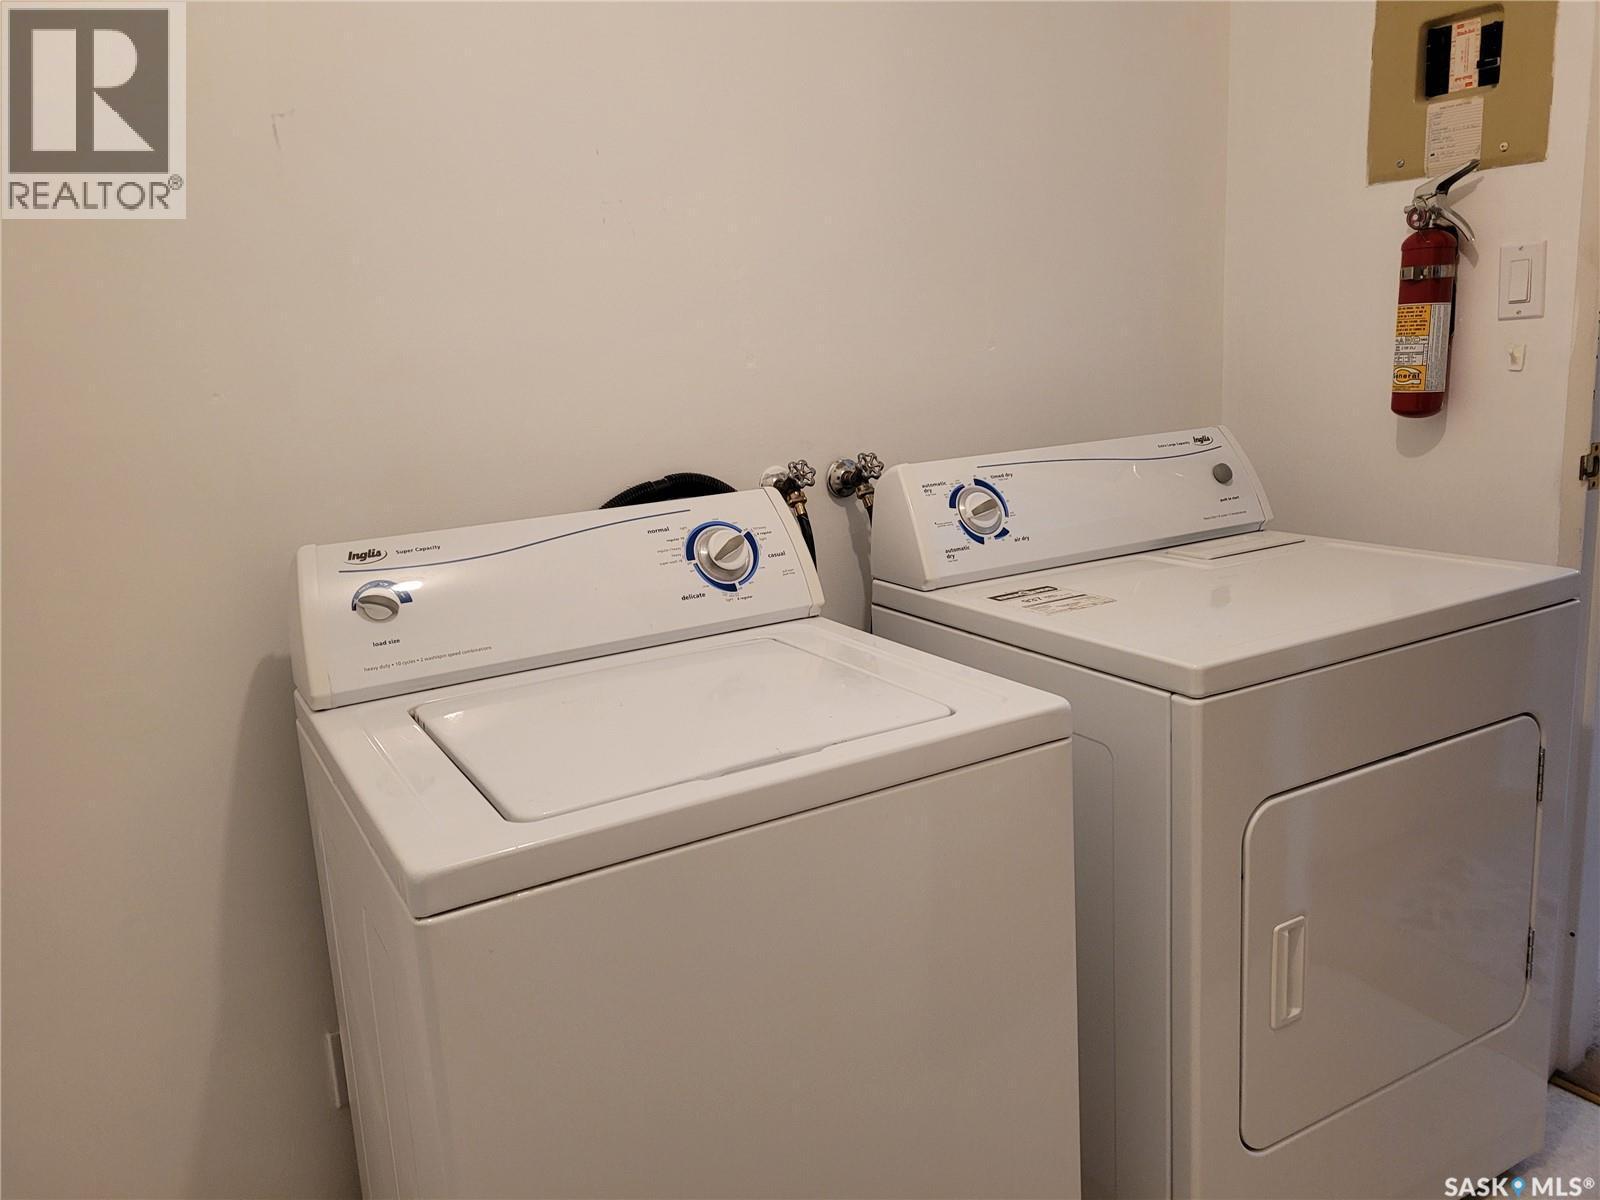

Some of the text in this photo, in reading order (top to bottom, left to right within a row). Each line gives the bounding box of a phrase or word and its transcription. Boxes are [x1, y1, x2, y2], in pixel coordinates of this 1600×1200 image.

[1193, 435, 1210, 443] Inglis
[647, 526, 670, 535] normal
[396, 544, 441, 555] Super Capacity
[768, 550, 786, 559] casual
[945, 546, 969, 554] automatic
[348, 549, 381, 561] Inglis
[681, 591, 706, 601] delicate
[372, 638, 401, 648] load size
[379, 663, 391, 671] duty
[447, 650, 461, 658] speed
